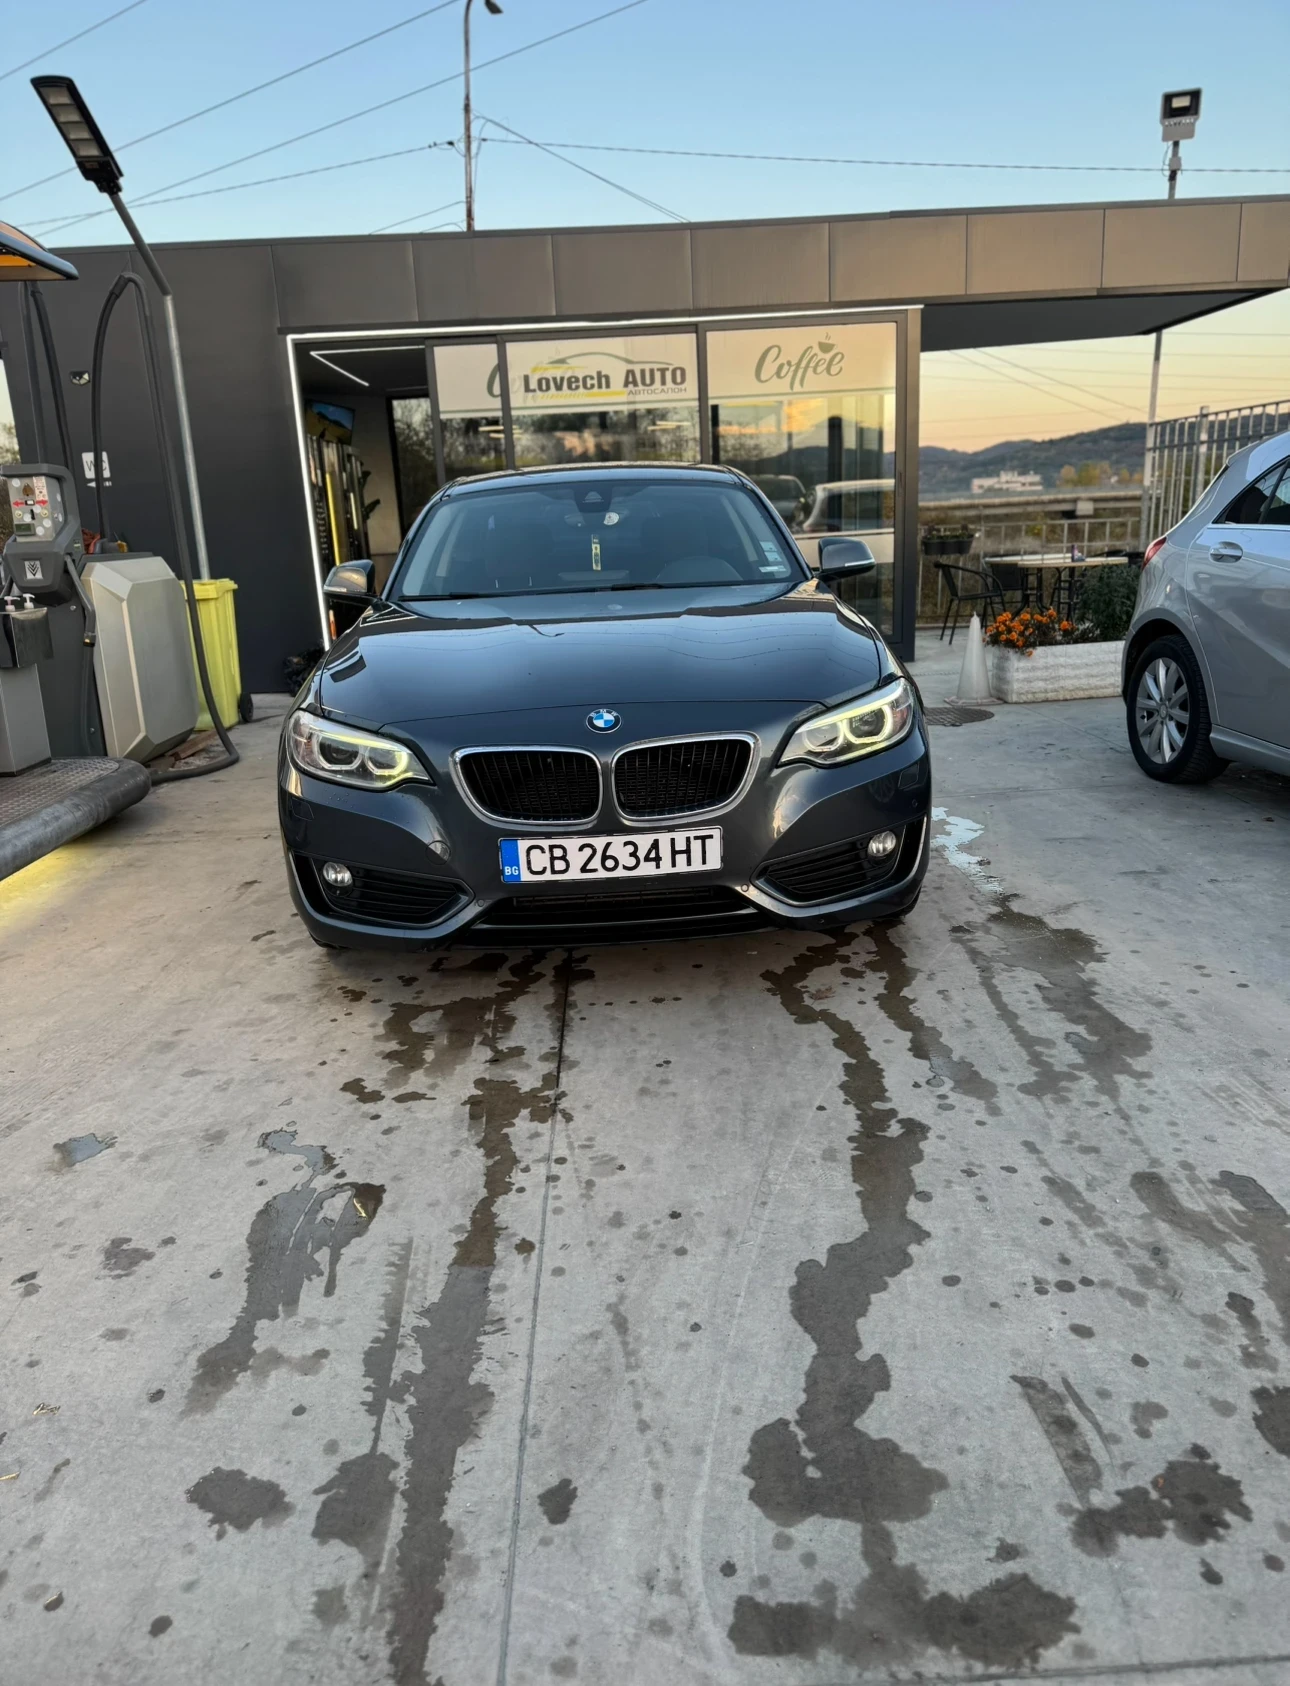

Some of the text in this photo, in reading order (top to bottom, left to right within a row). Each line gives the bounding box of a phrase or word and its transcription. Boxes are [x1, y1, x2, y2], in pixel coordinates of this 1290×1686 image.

[523, 370, 611, 394] Lovech
[623, 366, 687, 389] AUTO
[754, 344, 845, 392] Coffee
[627, 386, 688, 397] АВТОСАЛОН
[525, 834, 714, 876] CB 2634 HT
[504, 865, 519, 876] BG
